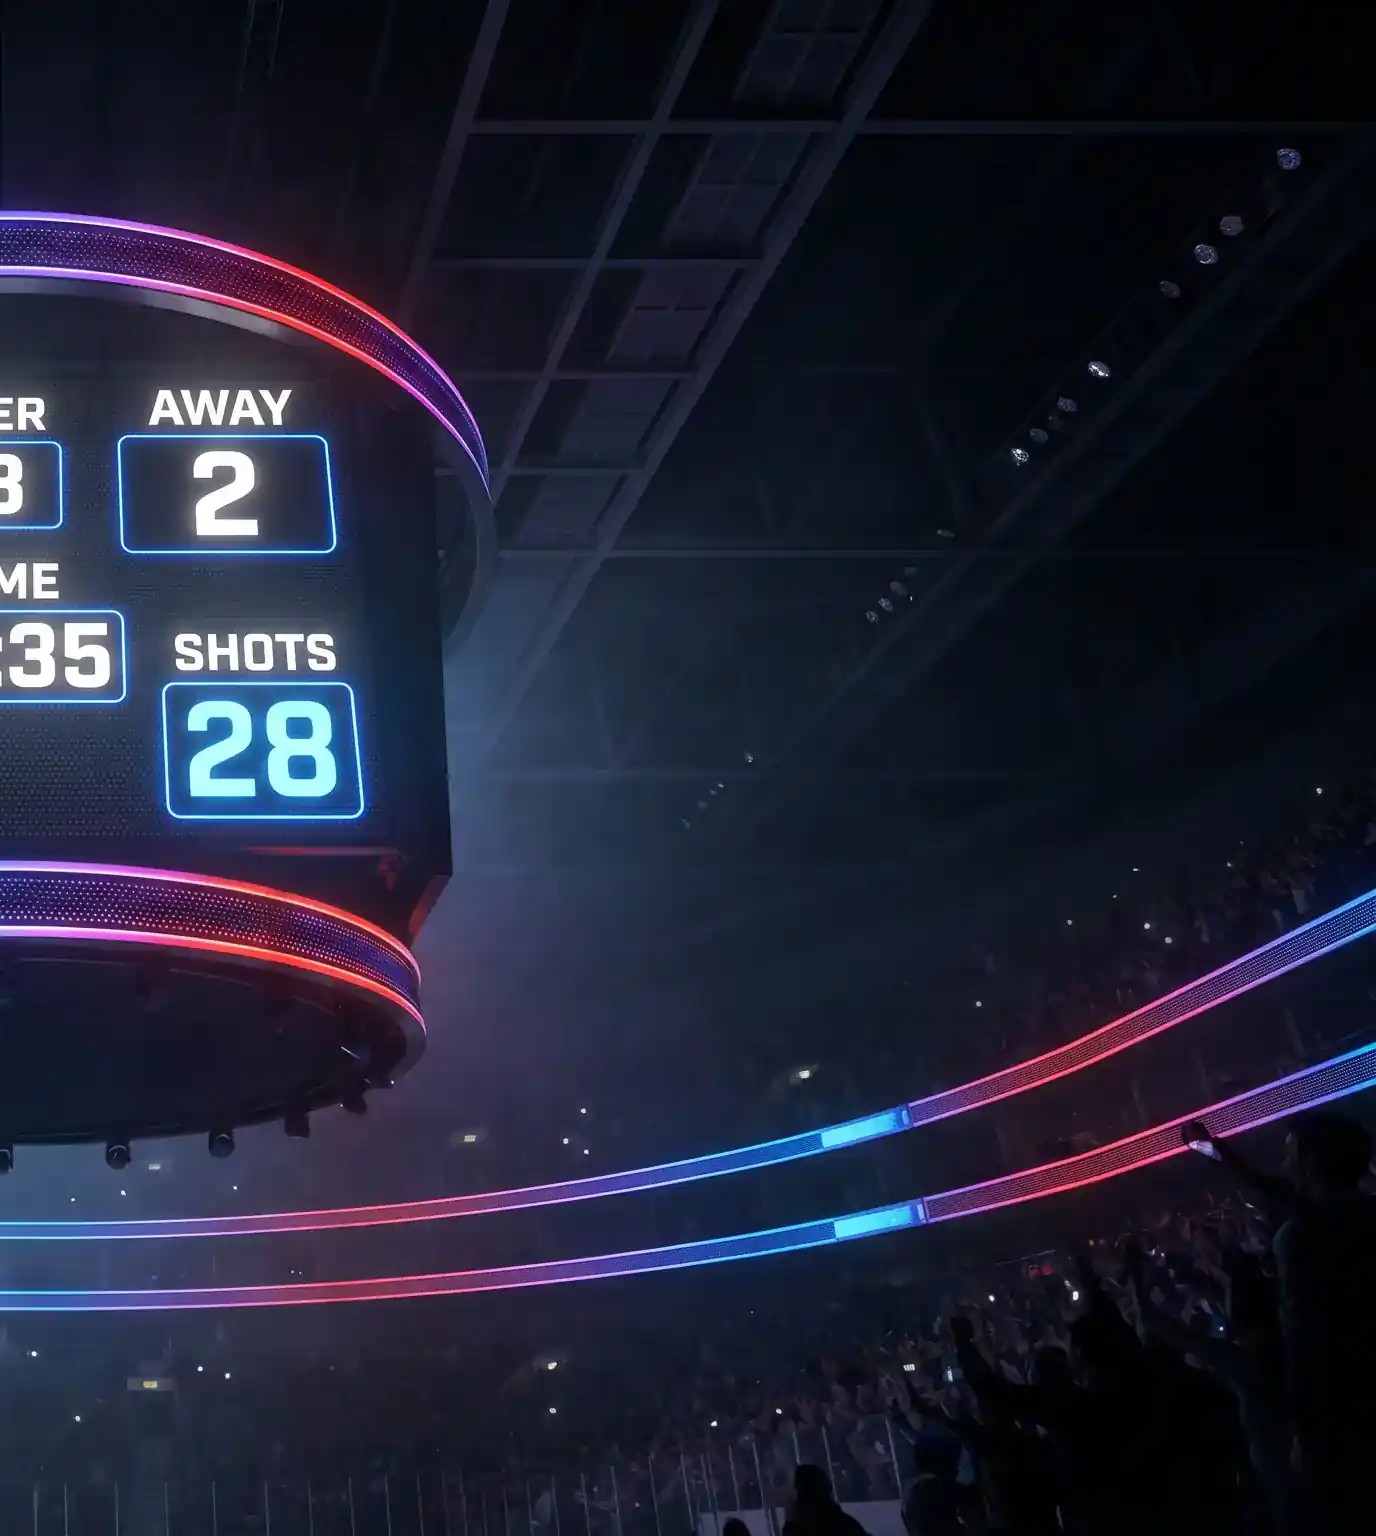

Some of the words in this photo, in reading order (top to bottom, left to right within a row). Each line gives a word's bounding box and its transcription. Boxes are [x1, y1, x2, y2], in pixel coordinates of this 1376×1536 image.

[148, 389, 293, 426] AWAY
[192, 450, 259, 536] 2
[174, 633, 337, 672] SHOTS
[187, 700, 337, 798] 28
